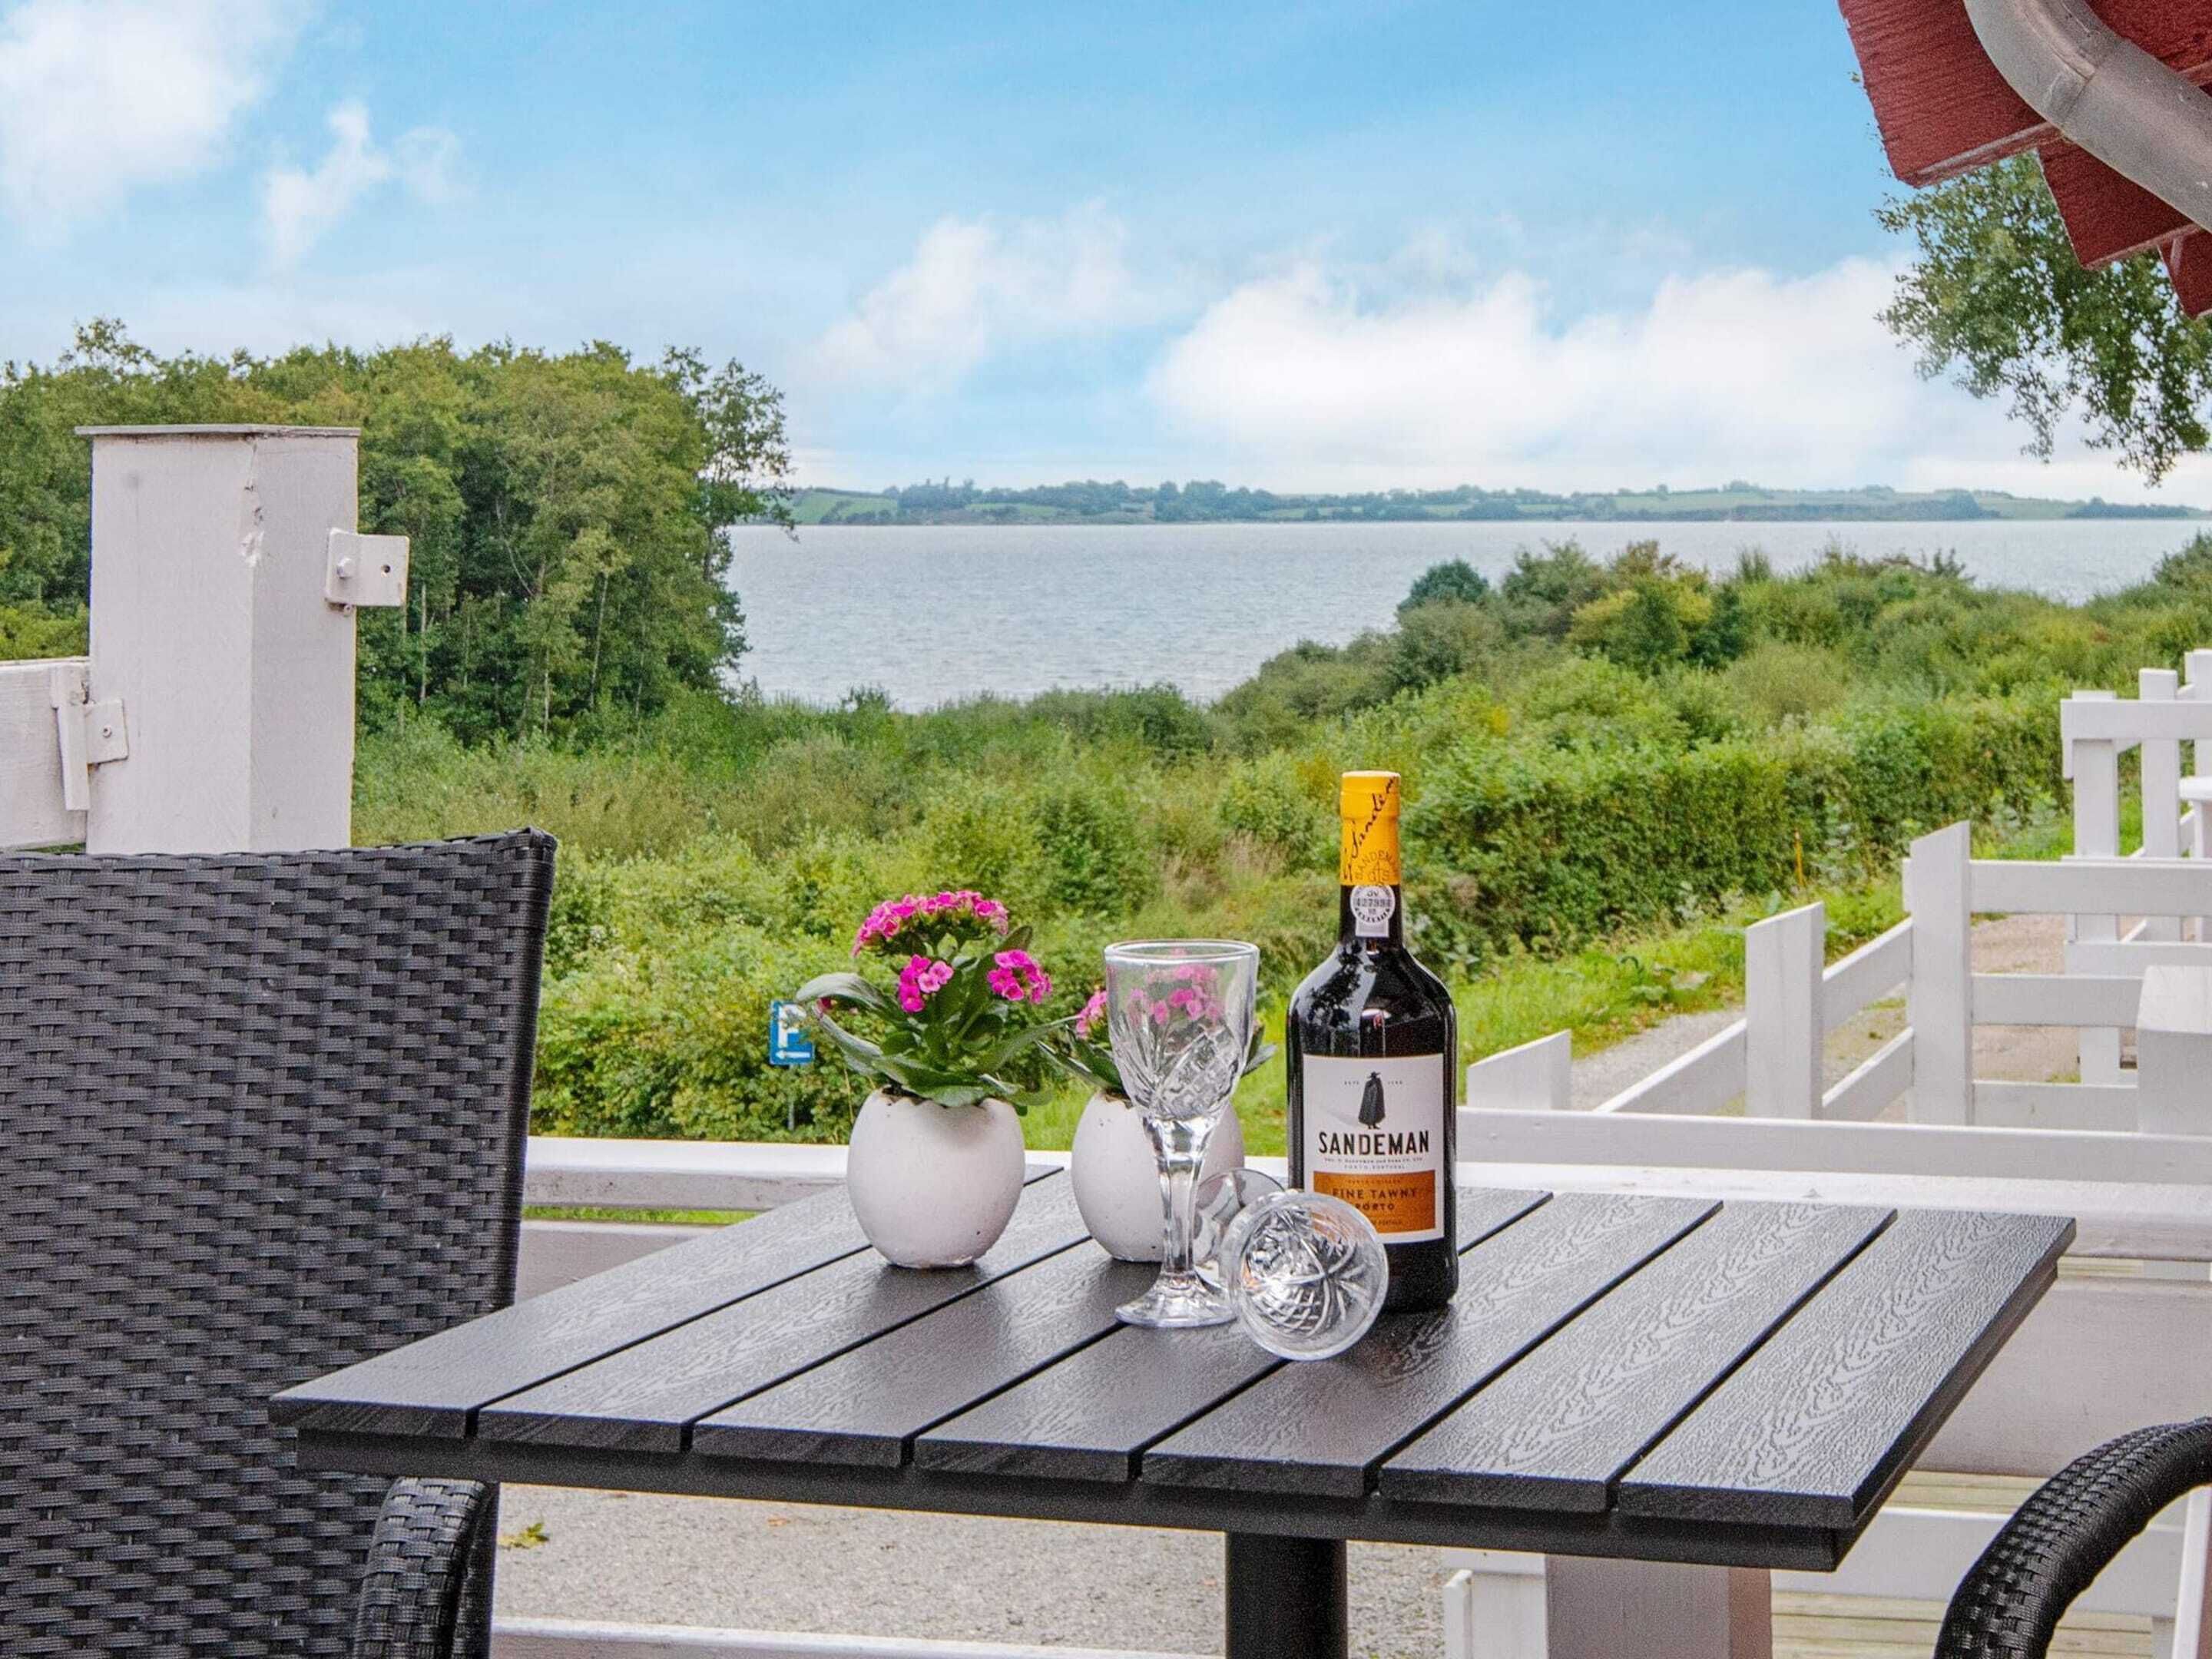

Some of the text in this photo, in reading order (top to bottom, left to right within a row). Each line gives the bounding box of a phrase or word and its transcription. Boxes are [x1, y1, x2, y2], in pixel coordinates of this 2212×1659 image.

[1319, 1130, 1429, 1155] SANDEMAN
[1332, 1187, 1418, 1200] FINE TAWNY
